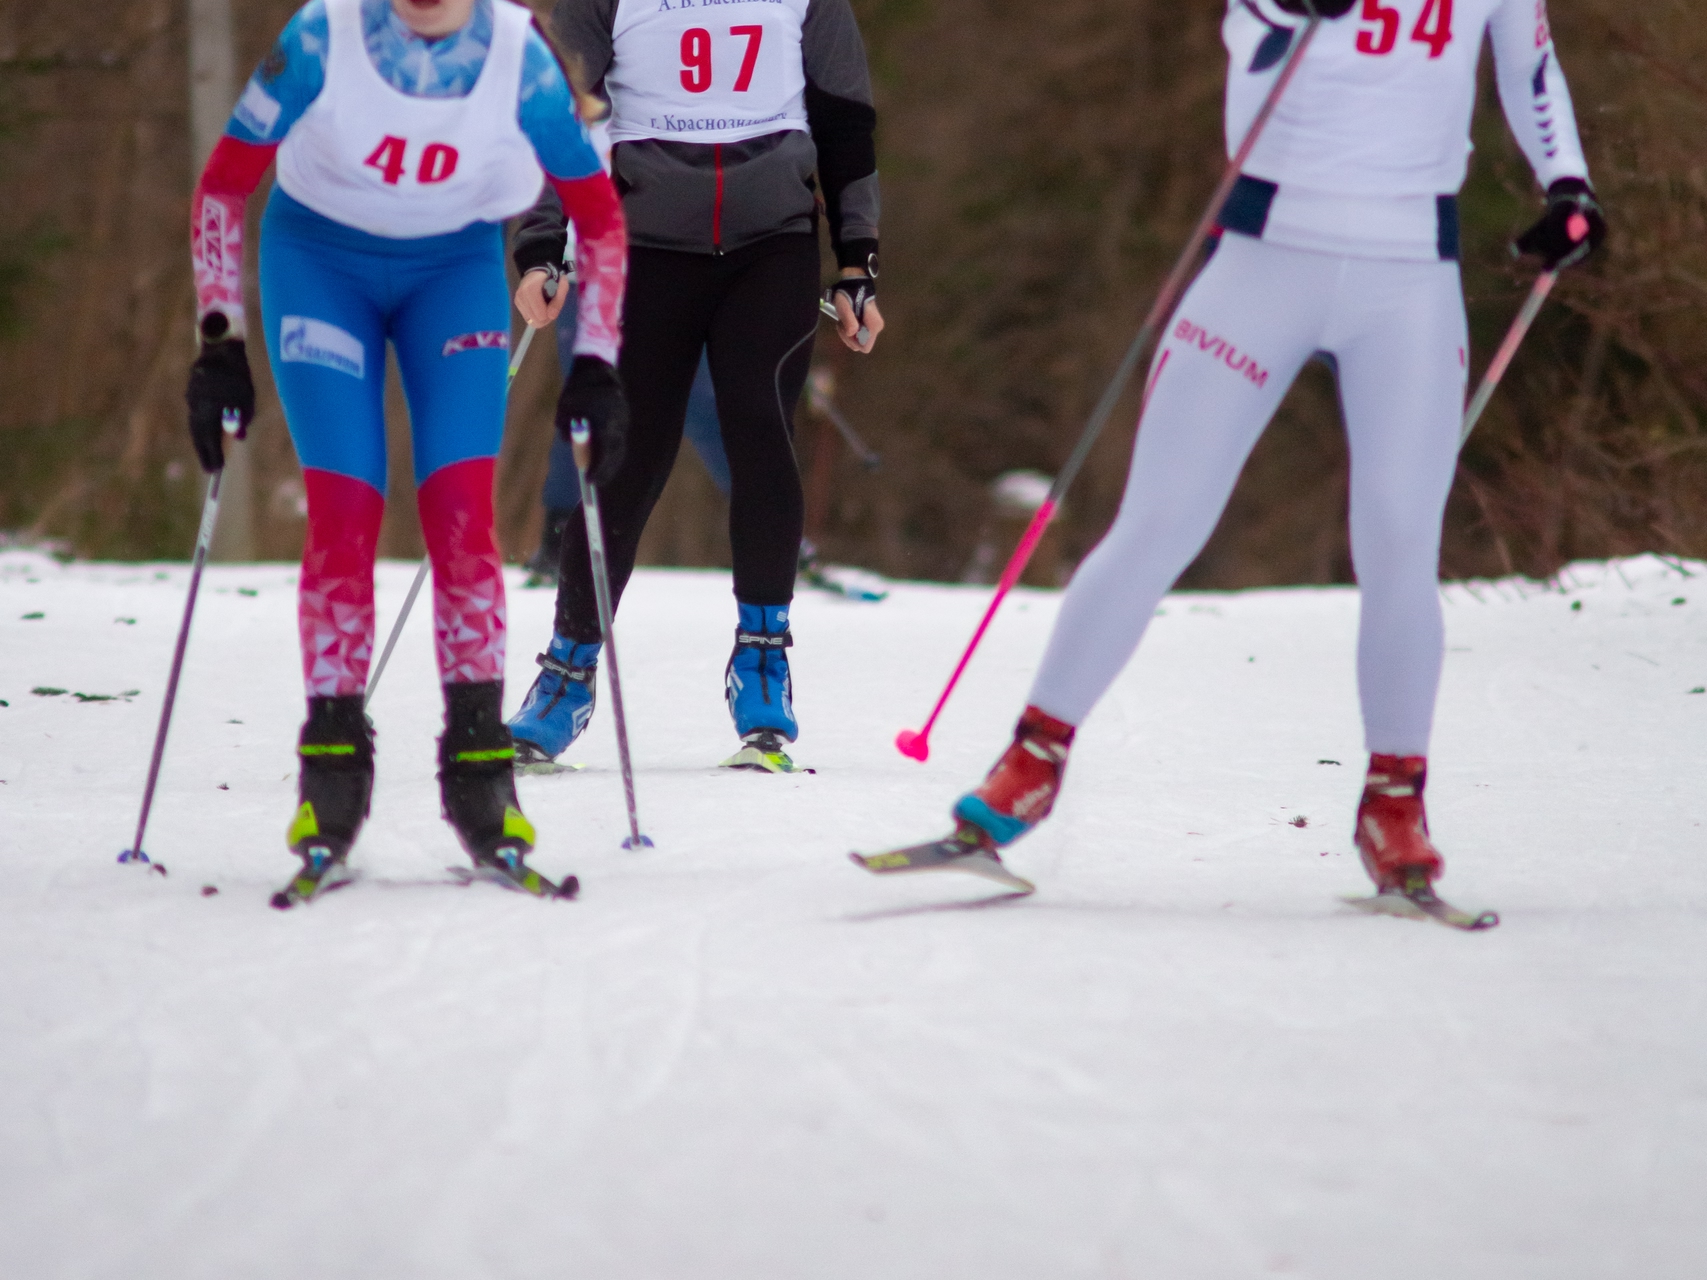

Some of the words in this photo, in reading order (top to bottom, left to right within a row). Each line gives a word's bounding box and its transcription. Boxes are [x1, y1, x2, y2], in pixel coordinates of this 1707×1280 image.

[679, 25, 763, 93] 97
[363, 134, 459, 186] 40
[1174, 318, 1268, 389] BIVIUM
[738, 635, 784, 645] SPINE
[543, 659, 585, 681] SPINE
